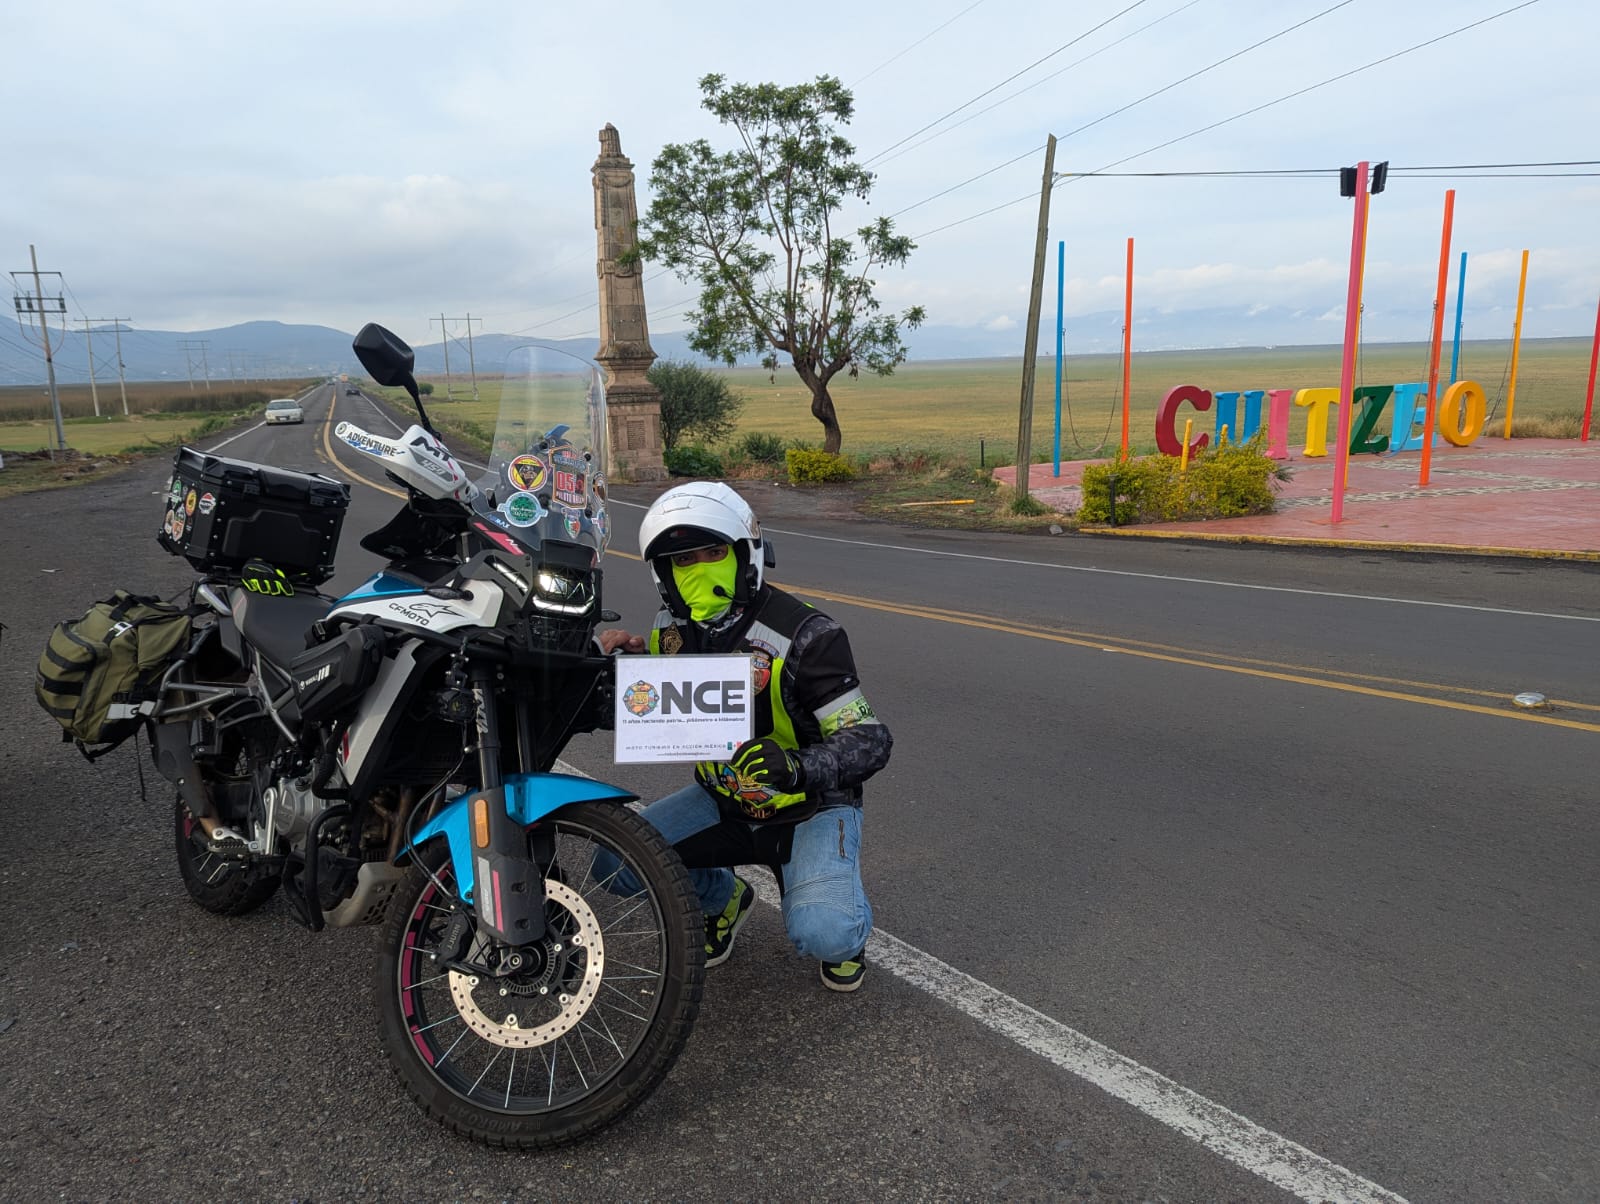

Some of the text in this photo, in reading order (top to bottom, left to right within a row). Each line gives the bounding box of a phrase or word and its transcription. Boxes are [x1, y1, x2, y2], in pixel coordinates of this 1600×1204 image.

[1155, 380, 1486, 460] CUITZEO
[346, 431, 397, 457] ADVENTURE
[388, 602, 430, 627] CFMOTO
